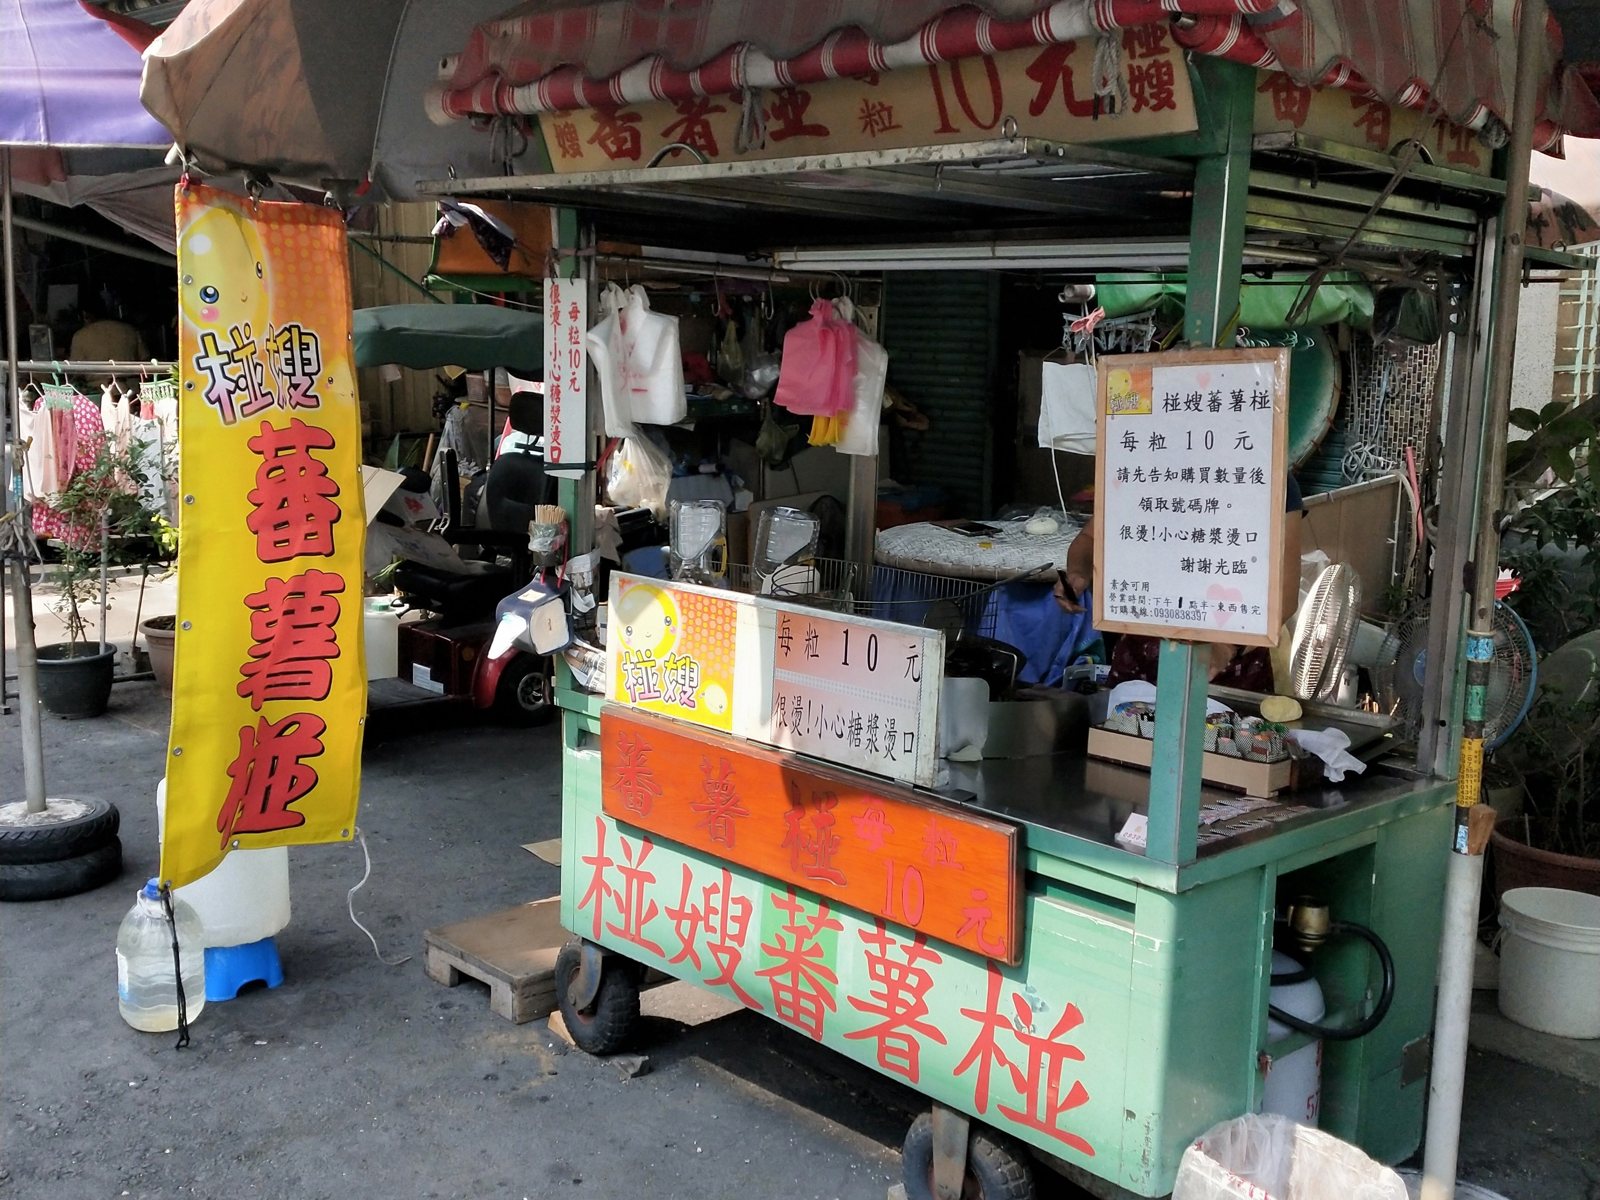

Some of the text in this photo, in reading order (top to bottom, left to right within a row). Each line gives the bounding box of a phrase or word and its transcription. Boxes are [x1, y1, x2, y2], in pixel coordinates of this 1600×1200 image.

[197, 322, 323, 425] 椪嫂
[1161, 388, 1272, 414] 椪嫂蕃薯椪
[1116, 466, 1267, 486] 請先告知購買數量後
[1138, 496, 1233, 515] 領取號碼牌。
[1180, 557, 1248, 576] 謝謝光臨
[1109, 579, 1150, 593] 素食可用
[217, 418, 345, 850] 蕃薯椪
[621, 648, 700, 710] 椪嫂
[577, 815, 1097, 1157] 椪嫂蕃薯椪
